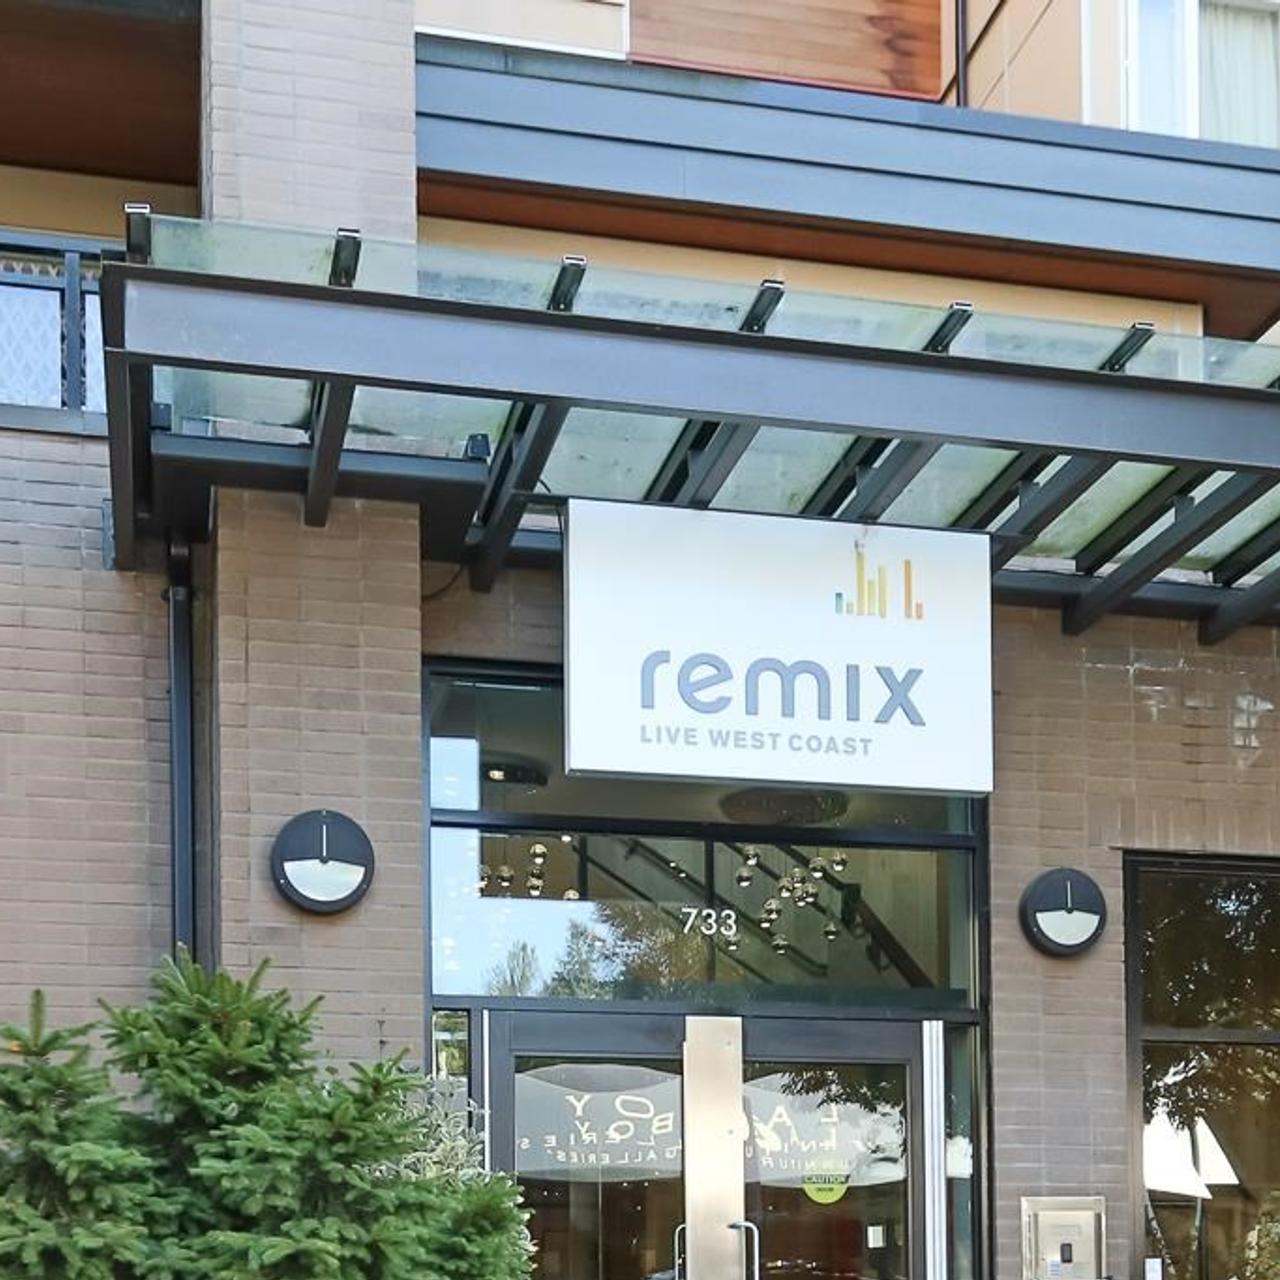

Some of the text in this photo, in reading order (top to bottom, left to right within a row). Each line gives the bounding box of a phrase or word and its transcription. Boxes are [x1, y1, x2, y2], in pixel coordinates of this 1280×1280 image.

[639, 649, 927, 727] remix
[639, 724, 873, 757] LIVE WEST COAST
[680, 907, 738, 935] 733
